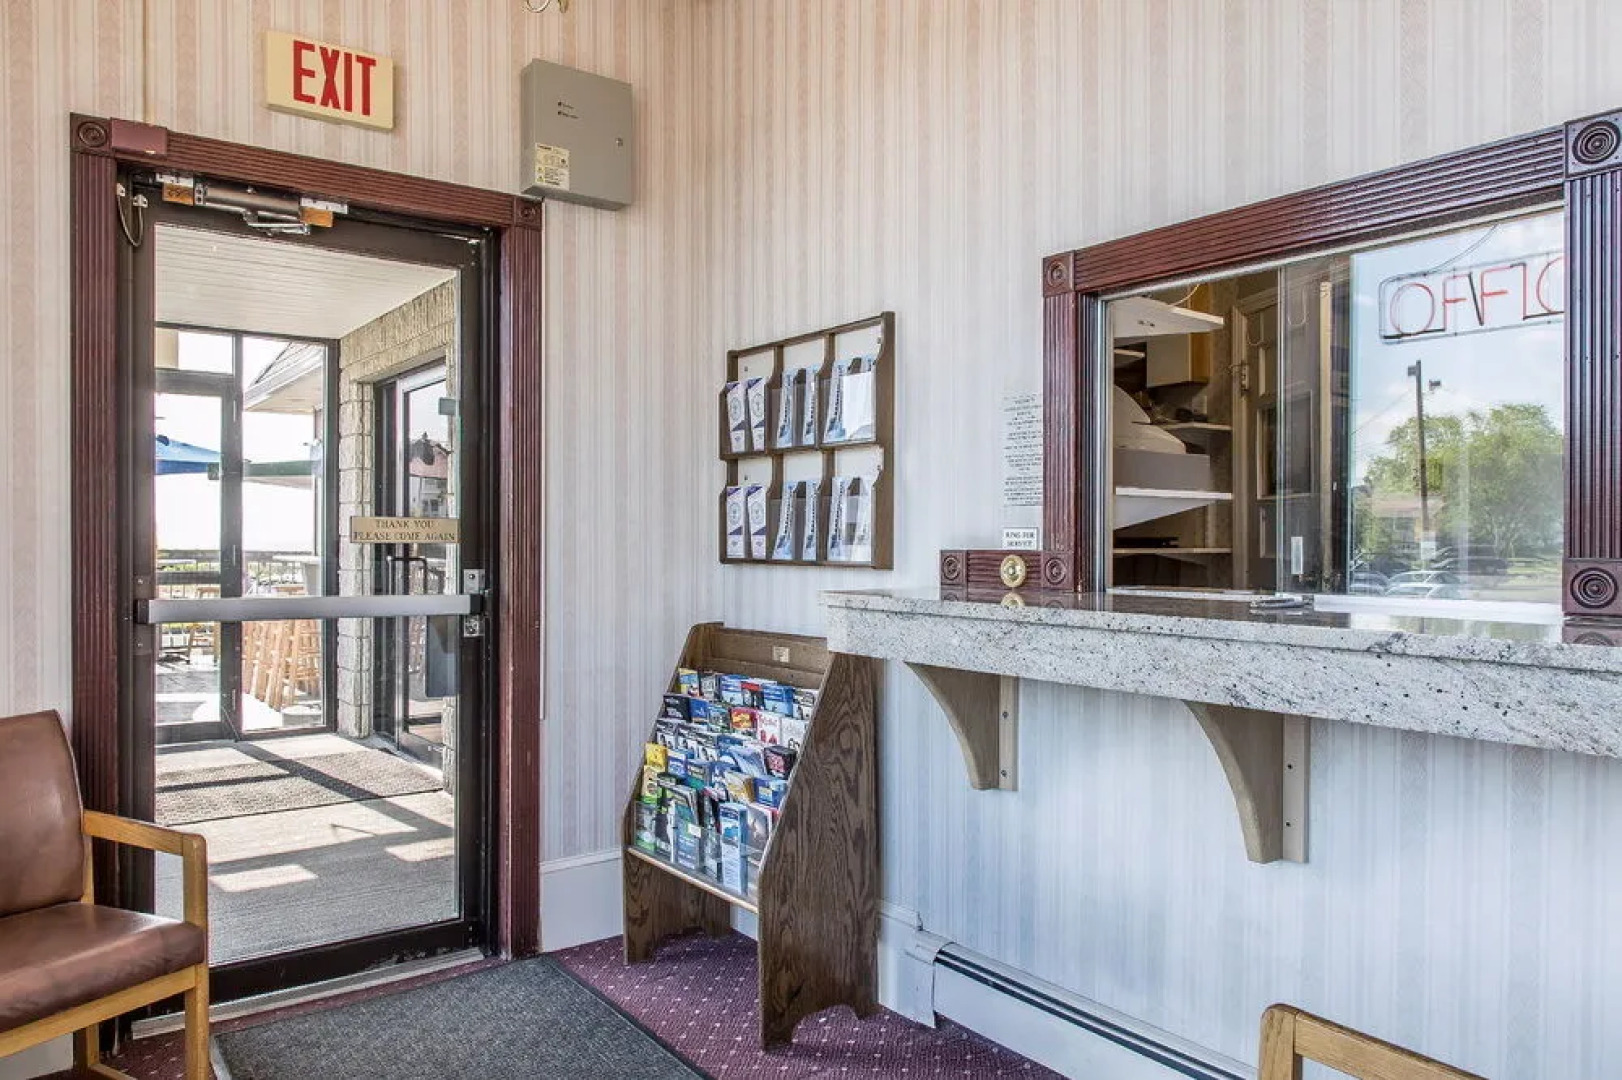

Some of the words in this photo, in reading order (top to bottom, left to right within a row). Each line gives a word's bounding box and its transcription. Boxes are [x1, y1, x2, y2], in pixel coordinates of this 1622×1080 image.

[293, 40, 377, 116] EXIT
[375, 519, 411, 529] THANK
[414, 519, 434, 529] YOU
[353, 531, 391, 541] PLEASE
[394, 531, 422, 541] COME
[425, 532, 455, 541] AGAIN
